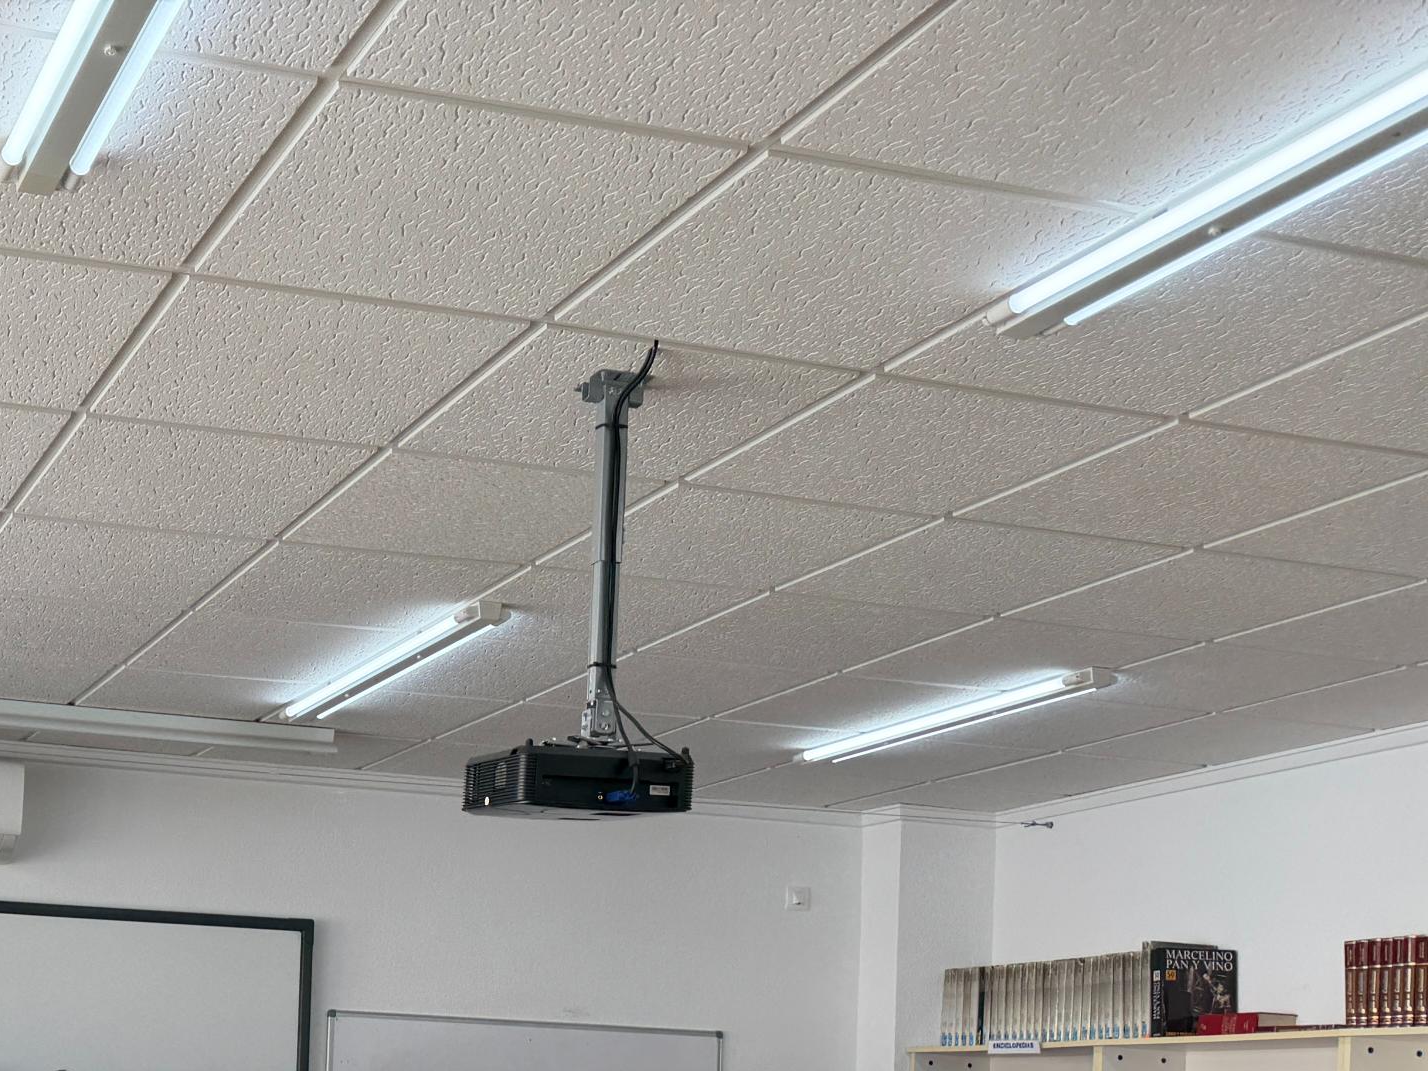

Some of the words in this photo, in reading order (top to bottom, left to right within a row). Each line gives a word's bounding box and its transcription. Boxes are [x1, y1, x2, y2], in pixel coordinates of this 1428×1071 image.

[1165, 949, 1233, 961] MARCELINO
[1166, 960, 1188, 969] PAN
[1191, 960, 1200, 970] Y
[1204, 961, 1233, 972] VINO
